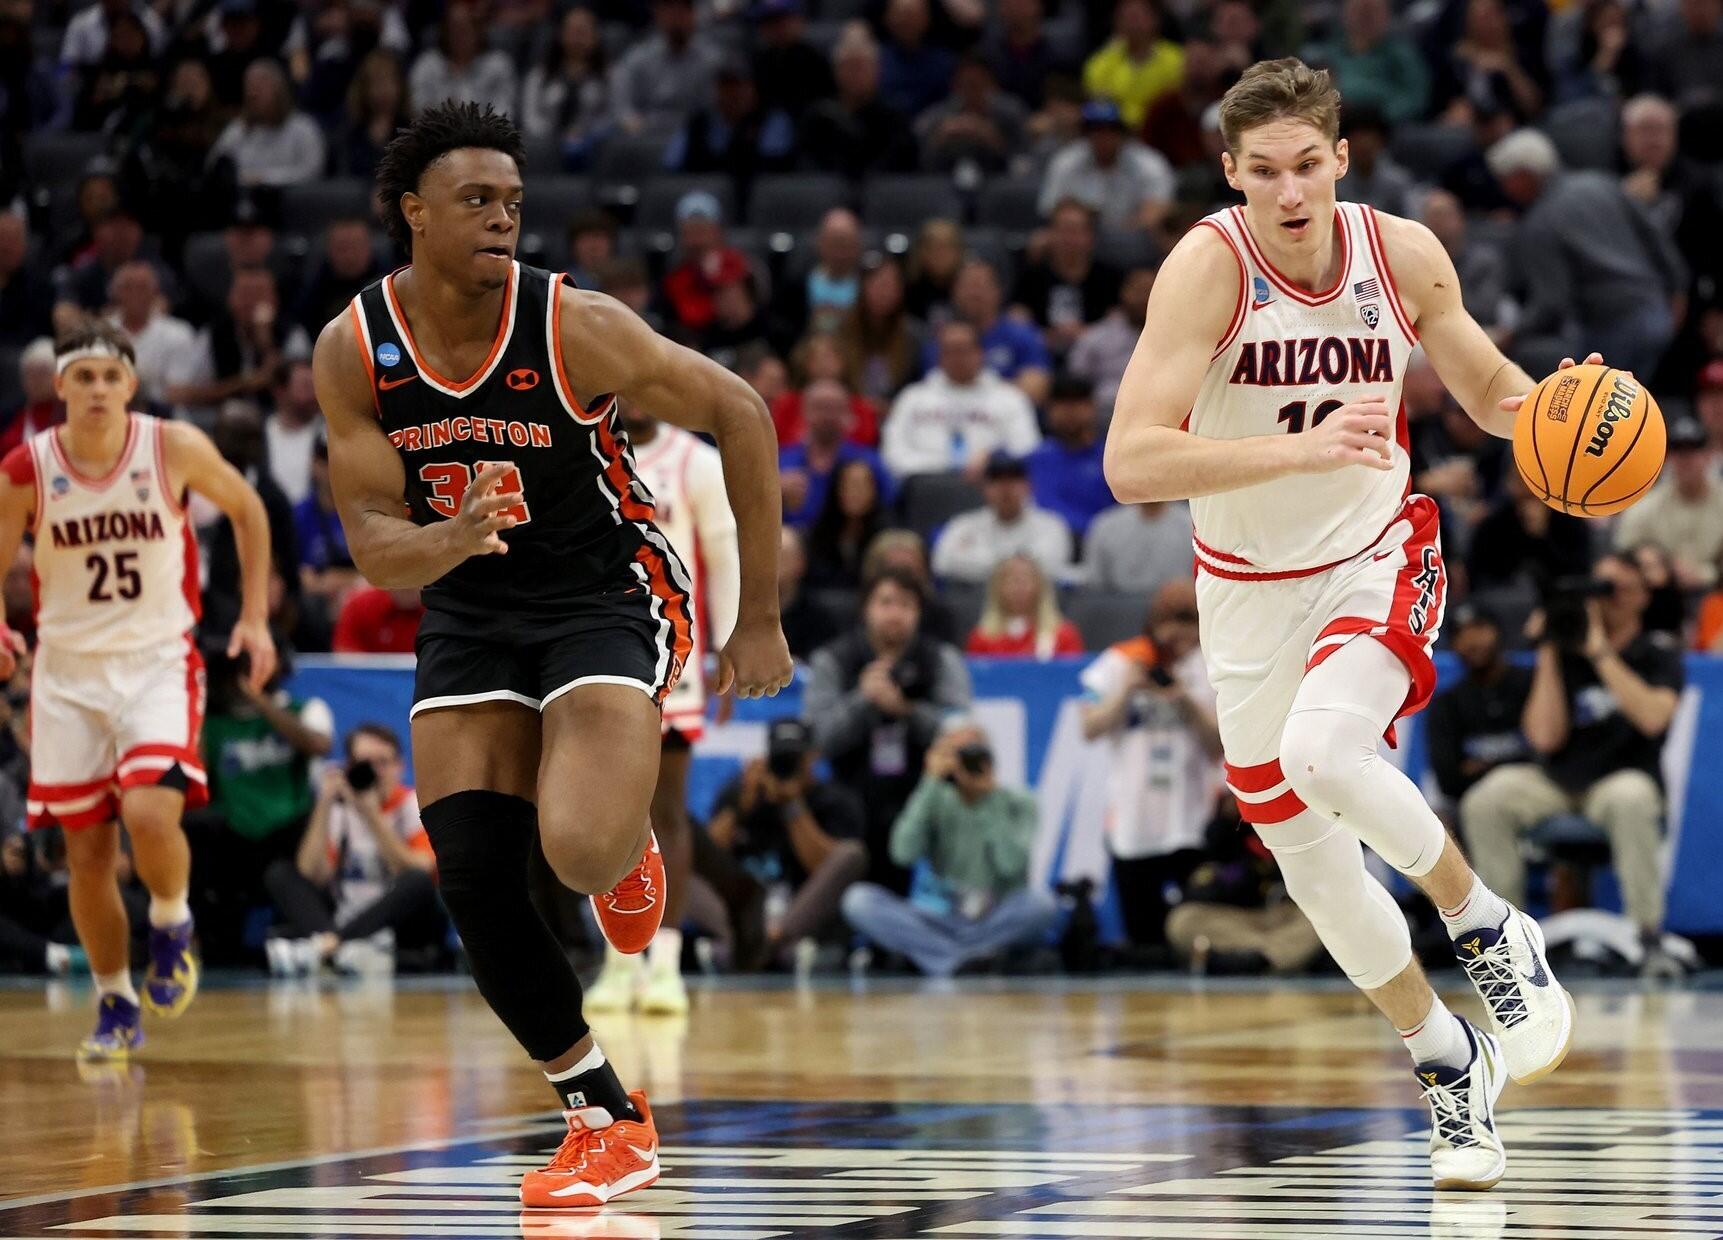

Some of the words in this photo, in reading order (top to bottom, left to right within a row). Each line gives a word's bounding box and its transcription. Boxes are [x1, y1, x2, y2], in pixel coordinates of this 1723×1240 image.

[1229, 336, 1394, 386] ARIZONA
[388, 416, 552, 451] PRINCETON
[1584, 376, 1638, 457] Wilson
[51, 510, 165, 548] ARIZONA
[86, 552, 142, 601] 25
